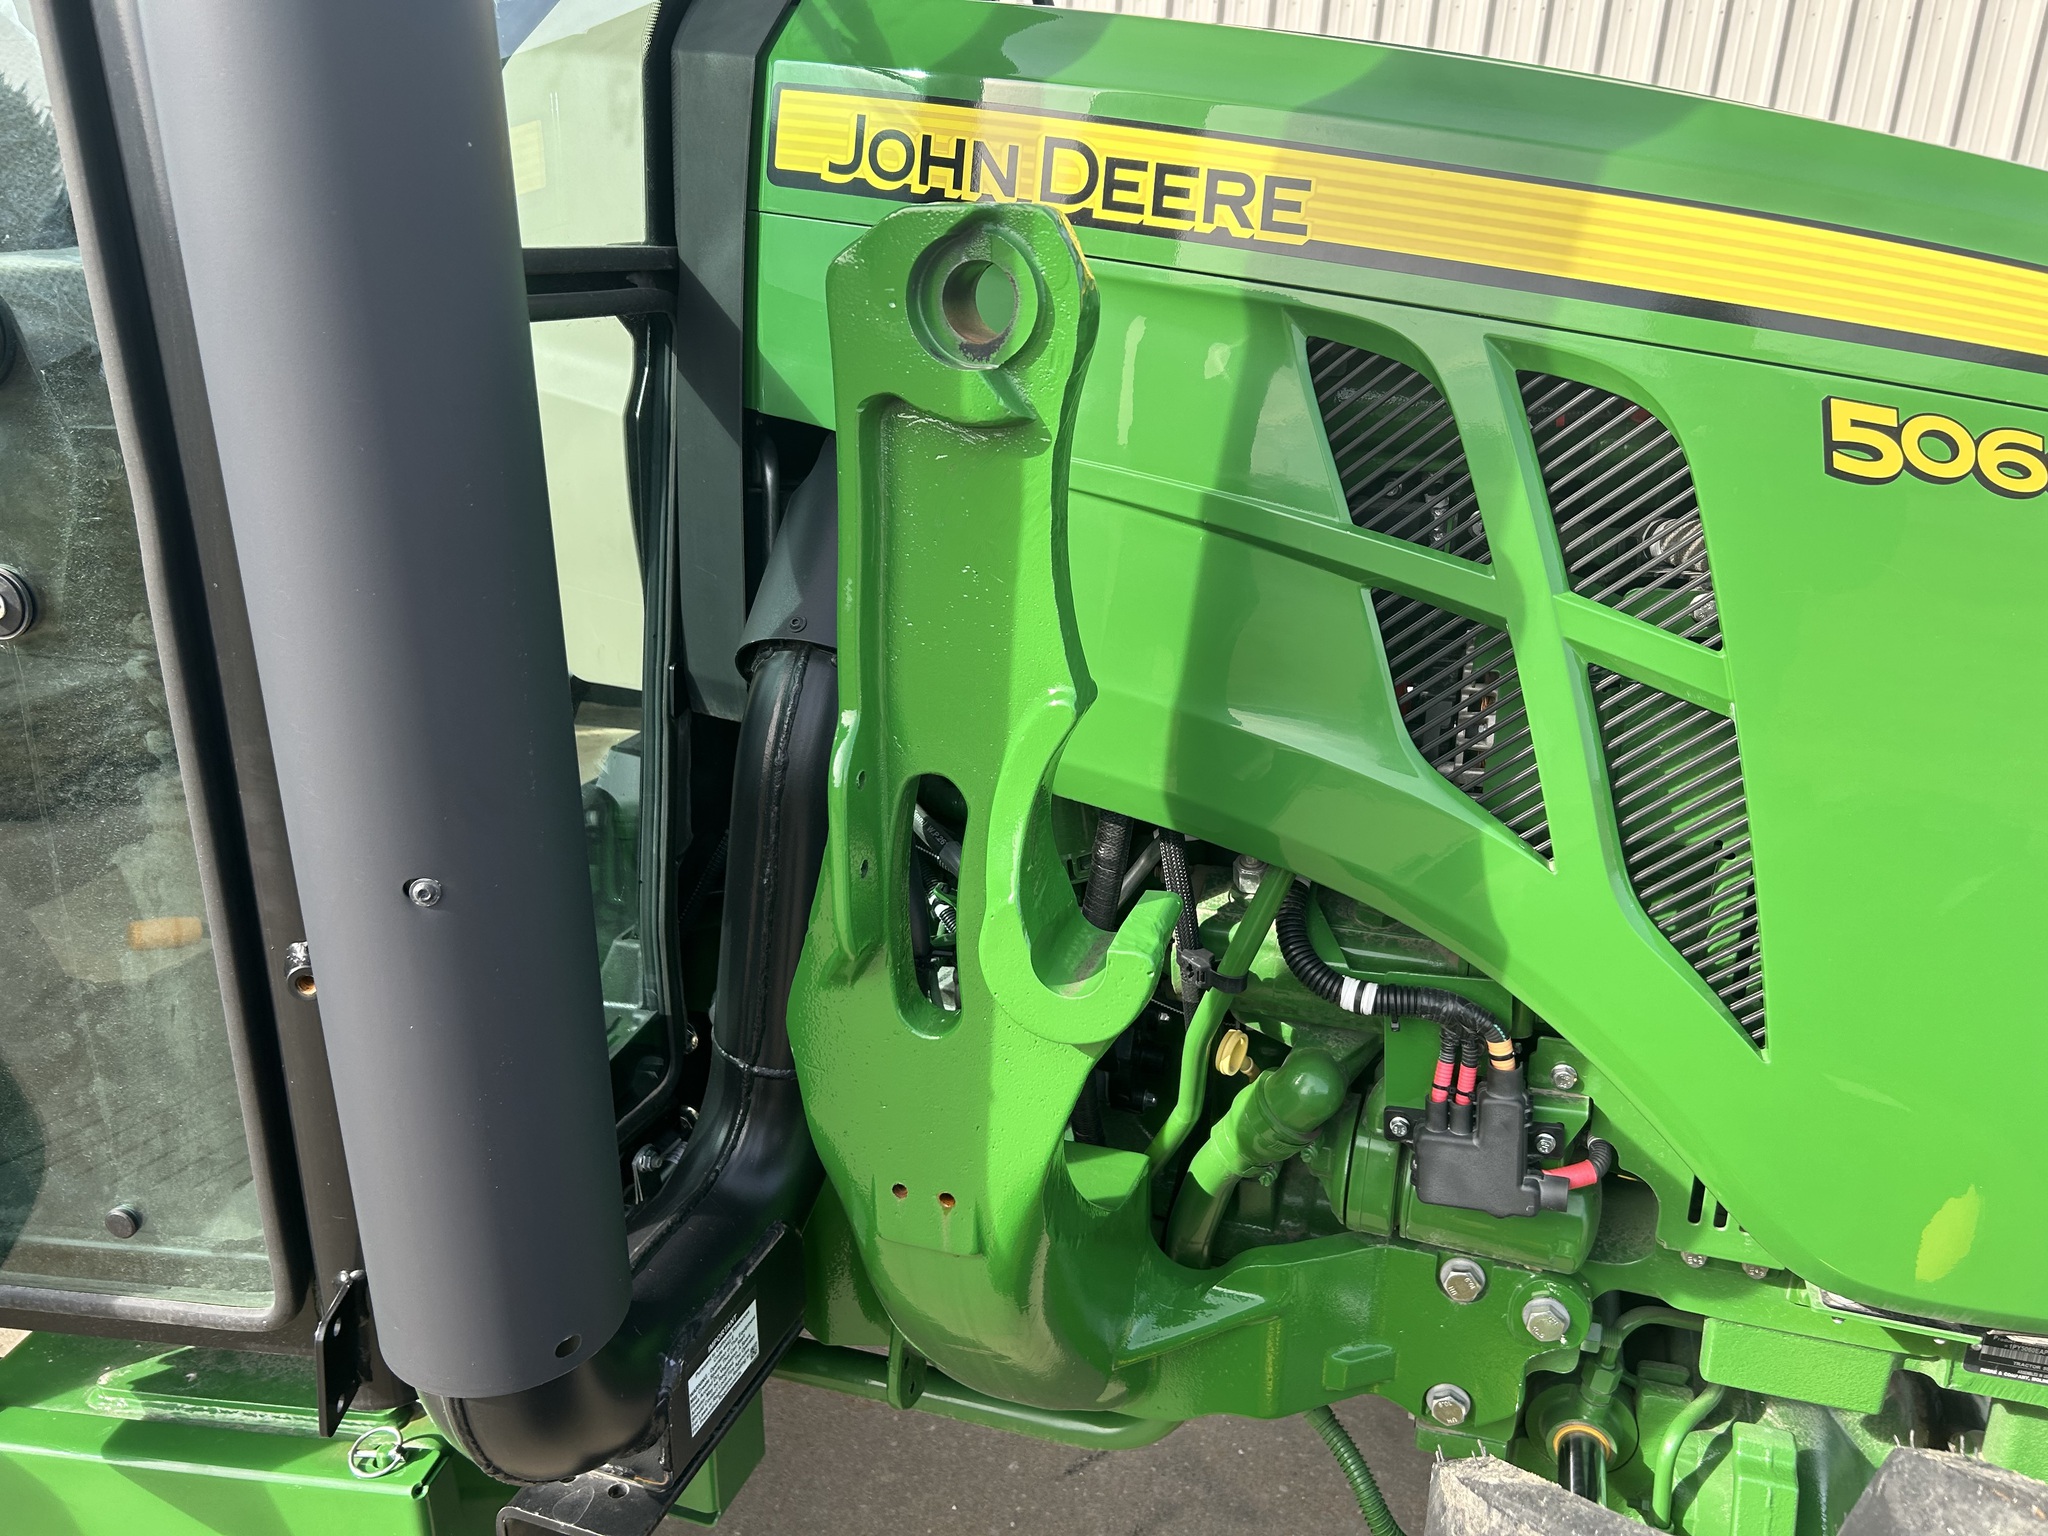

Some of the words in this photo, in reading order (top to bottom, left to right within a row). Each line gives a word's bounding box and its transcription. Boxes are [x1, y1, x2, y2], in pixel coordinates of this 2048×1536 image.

[828, 114, 1020, 198] JOHN
[1039, 137, 1313, 236] DEERE
[707, 1312, 737, 1354] IMPORTANT
[2012, 1361, 2040, 1370] TRACTOR
